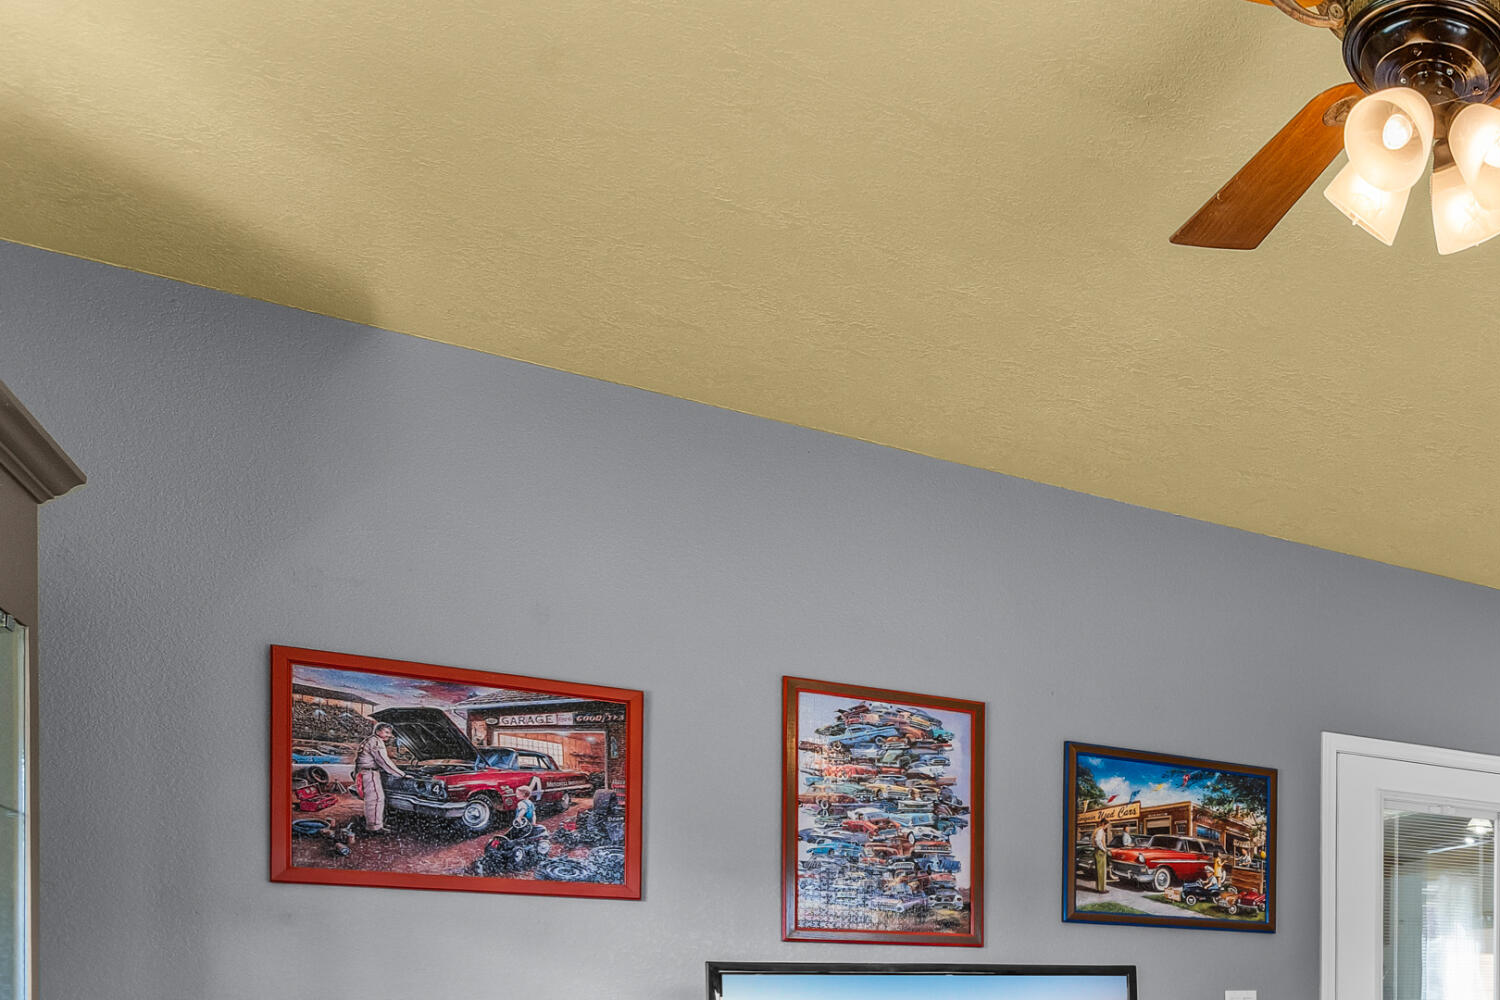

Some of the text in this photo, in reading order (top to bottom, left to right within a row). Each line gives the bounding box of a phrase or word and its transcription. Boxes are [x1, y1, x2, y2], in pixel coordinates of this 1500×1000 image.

[501, 714, 554, 725] GARAGE
[432, 785, 440, 794] 4
[1118, 805, 1137, 818] Cars
